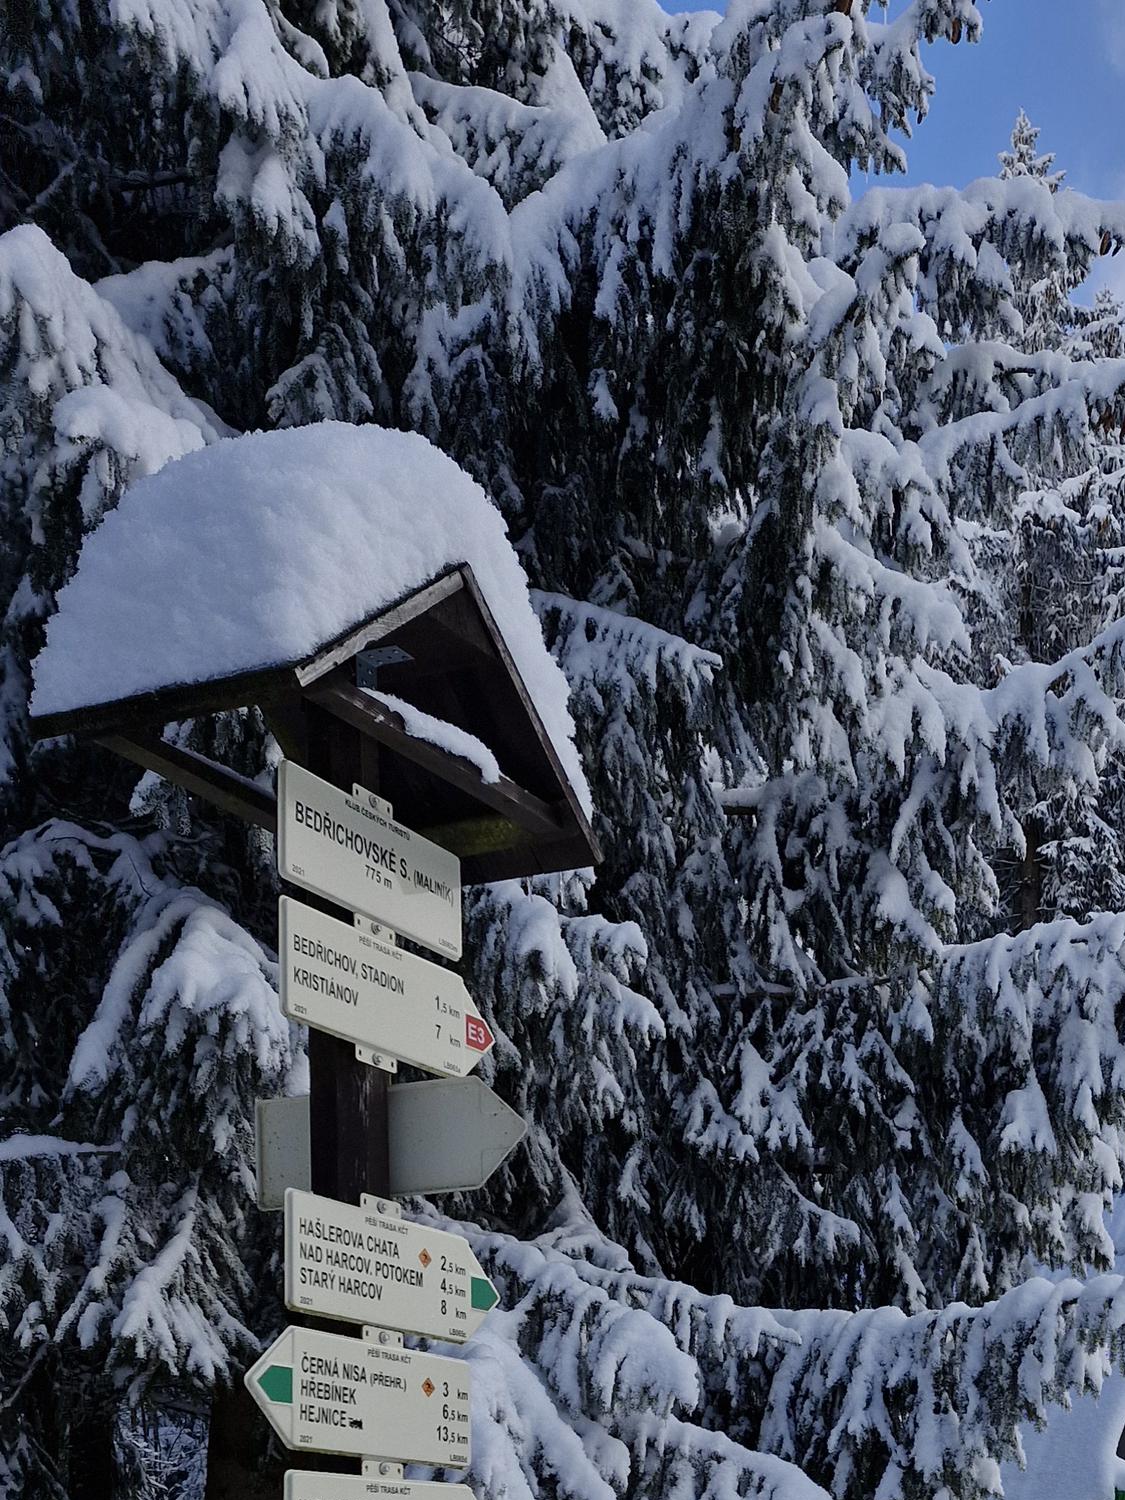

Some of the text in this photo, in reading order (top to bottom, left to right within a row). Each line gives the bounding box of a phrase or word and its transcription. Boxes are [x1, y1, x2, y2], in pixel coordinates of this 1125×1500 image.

[345, 798, 360, 813] KLUB
[295, 801, 454, 907] BEDŘICHOVSKÉ S. (MALINÍK)
[292, 864, 305, 876] 2021
[365, 865, 392, 889] 775 m
[294, 934, 404, 994] BEDŘICHOV, STADION
[293, 967, 358, 1006] KRISTIÁNOV
[294, 1003, 307, 1015] 2021
[435, 996, 460, 1018] 1,5 km
[435, 1025, 460, 1048] 7 km
[467, 1021, 485, 1043] E3
[365, 1217, 377, 1227] PĚŠÍ
[379, 1219, 397, 1232] TRASA
[300, 1217, 399, 1258] HAŠLEROVA CHATA
[300, 1244, 423, 1287] NAD HARCOV. POTOKEM
[441, 1255, 466, 1276] 2,5 km
[300, 1267, 383, 1301] STARÝ HARCOV
[441, 1278, 466, 1298] 4,5 km
[300, 1296, 313, 1305] 2021
[441, 1300, 466, 1320] 8 km
[368, 1348, 380, 1358] PĚŠÍ
[381, 1351, 399, 1361] TRASA
[301, 1352, 407, 1392] ČERNÁ NISA (PŘEHR.)
[301, 1377, 357, 1405] HŘEBÍNEK
[443, 1382, 468, 1401] 3 km
[300, 1404, 347, 1428] HEJNICE
[442, 1404, 468, 1423] 6,5 km
[437, 1426, 468, 1445] 13,5 km
[366, 1484, 410, 1496] PĚŠÍ TRASA KČT
